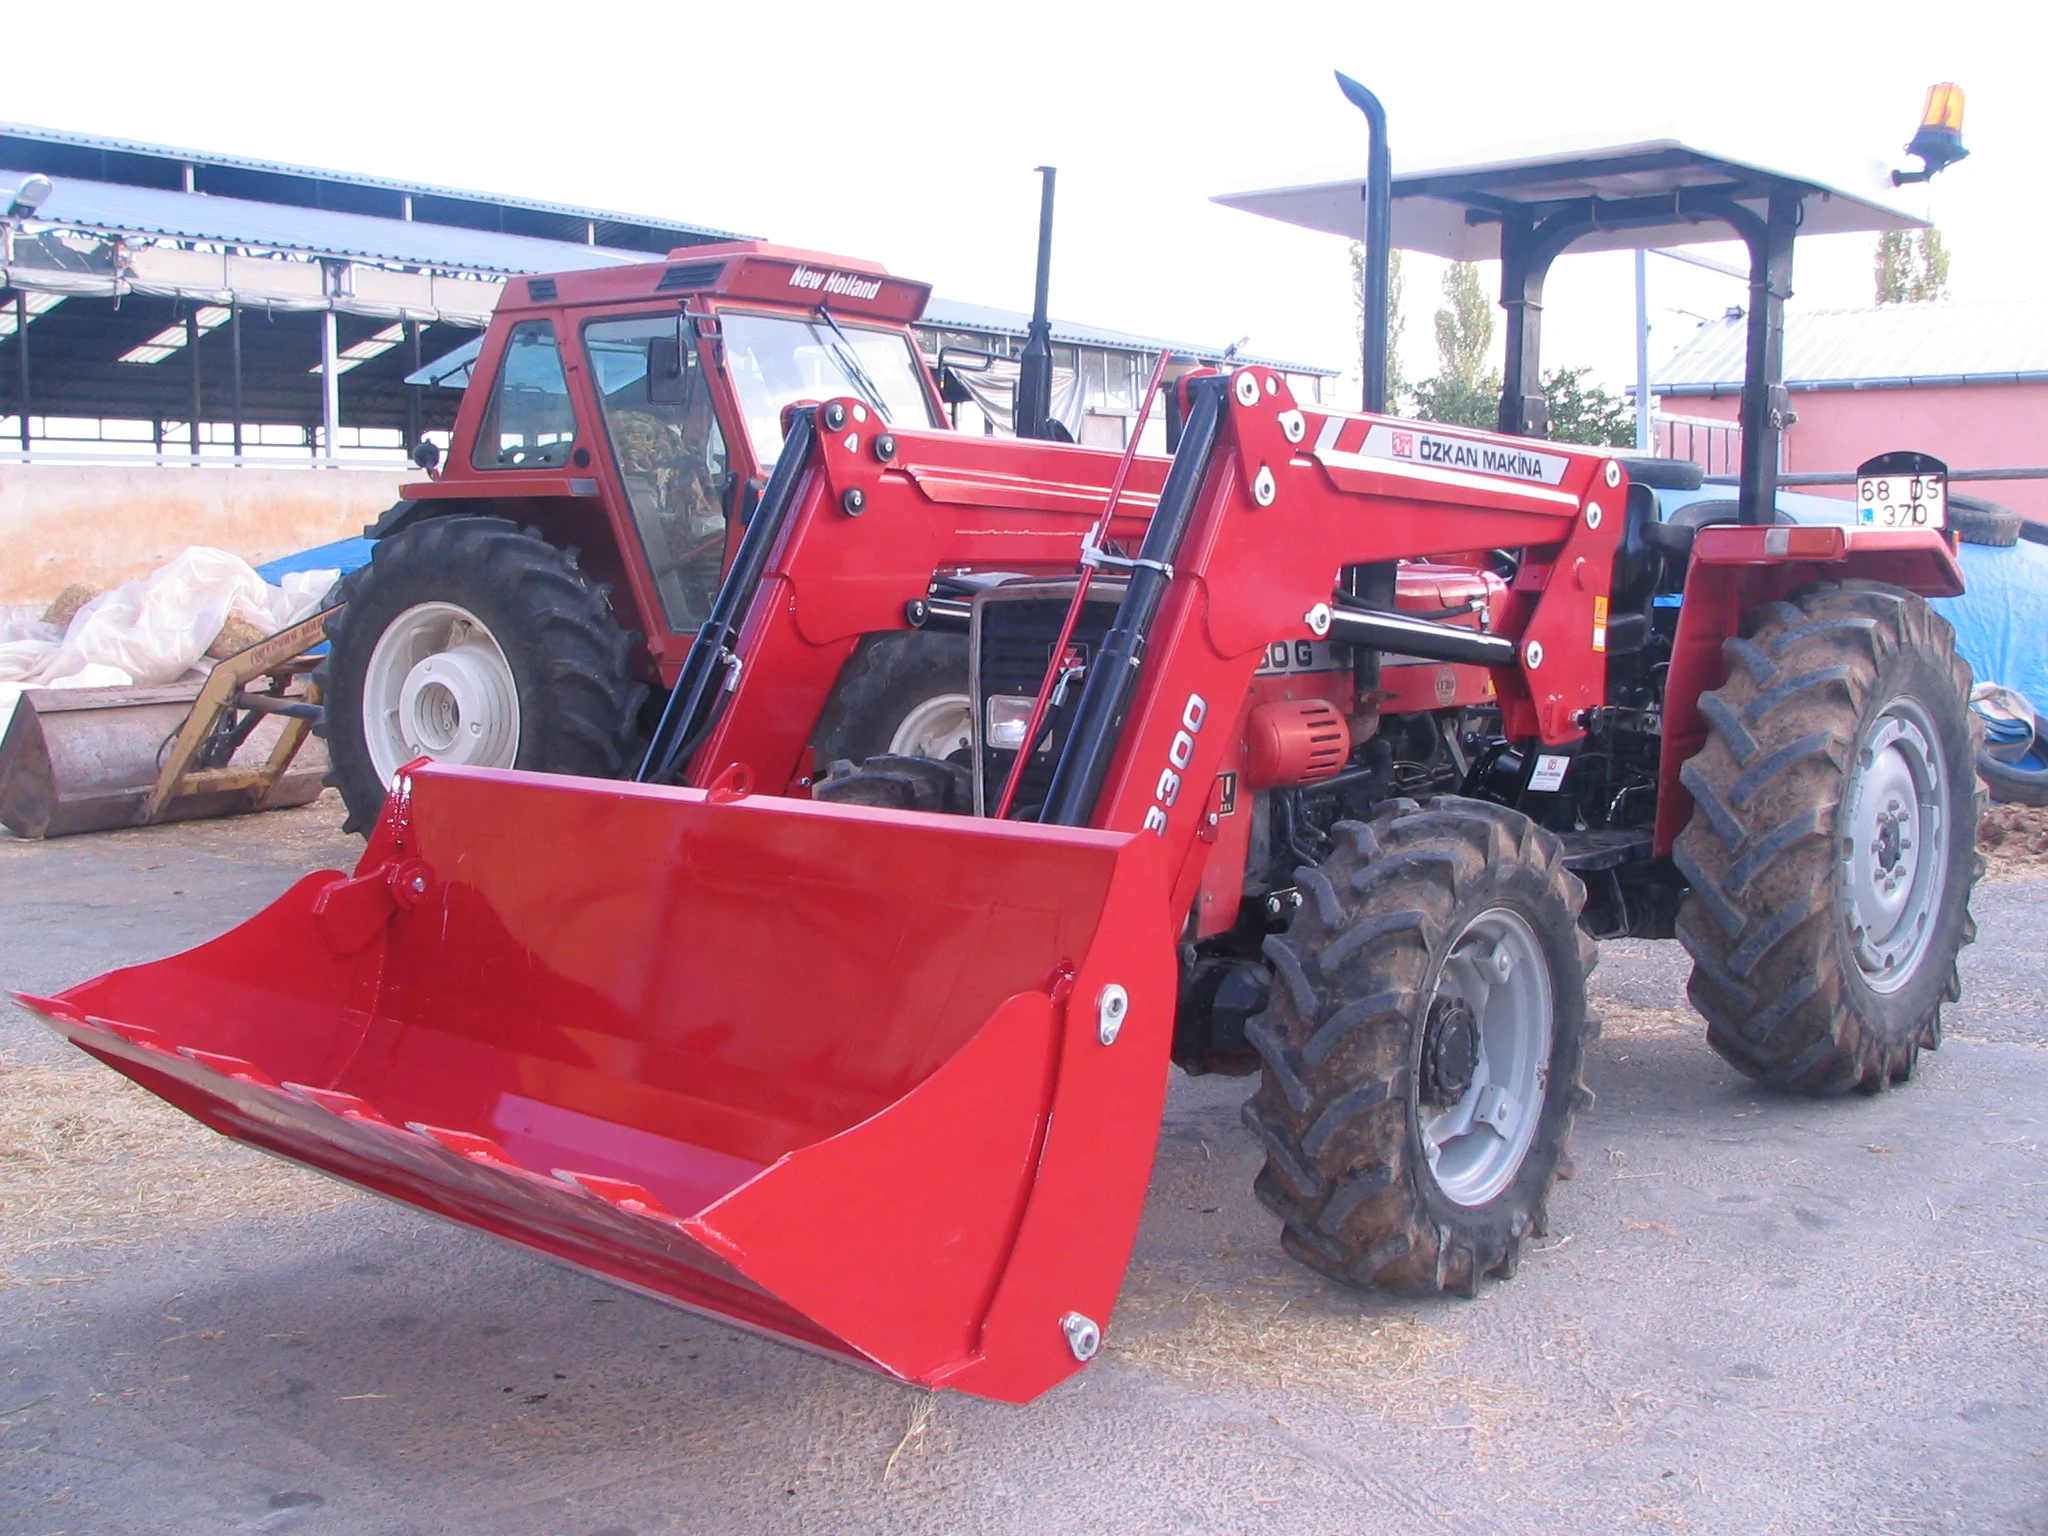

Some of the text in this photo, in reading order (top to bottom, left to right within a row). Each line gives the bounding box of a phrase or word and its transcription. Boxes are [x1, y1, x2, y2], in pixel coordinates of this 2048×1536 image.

[788, 265, 882, 300] New Holland
[1420, 436, 1478, 468] ÖZKAN
[1483, 451, 1543, 478] MAKİNA
[1861, 479, 1939, 501] 68 DS
[1883, 503, 1927, 527] 370
[1143, 693, 1208, 838] 3300
